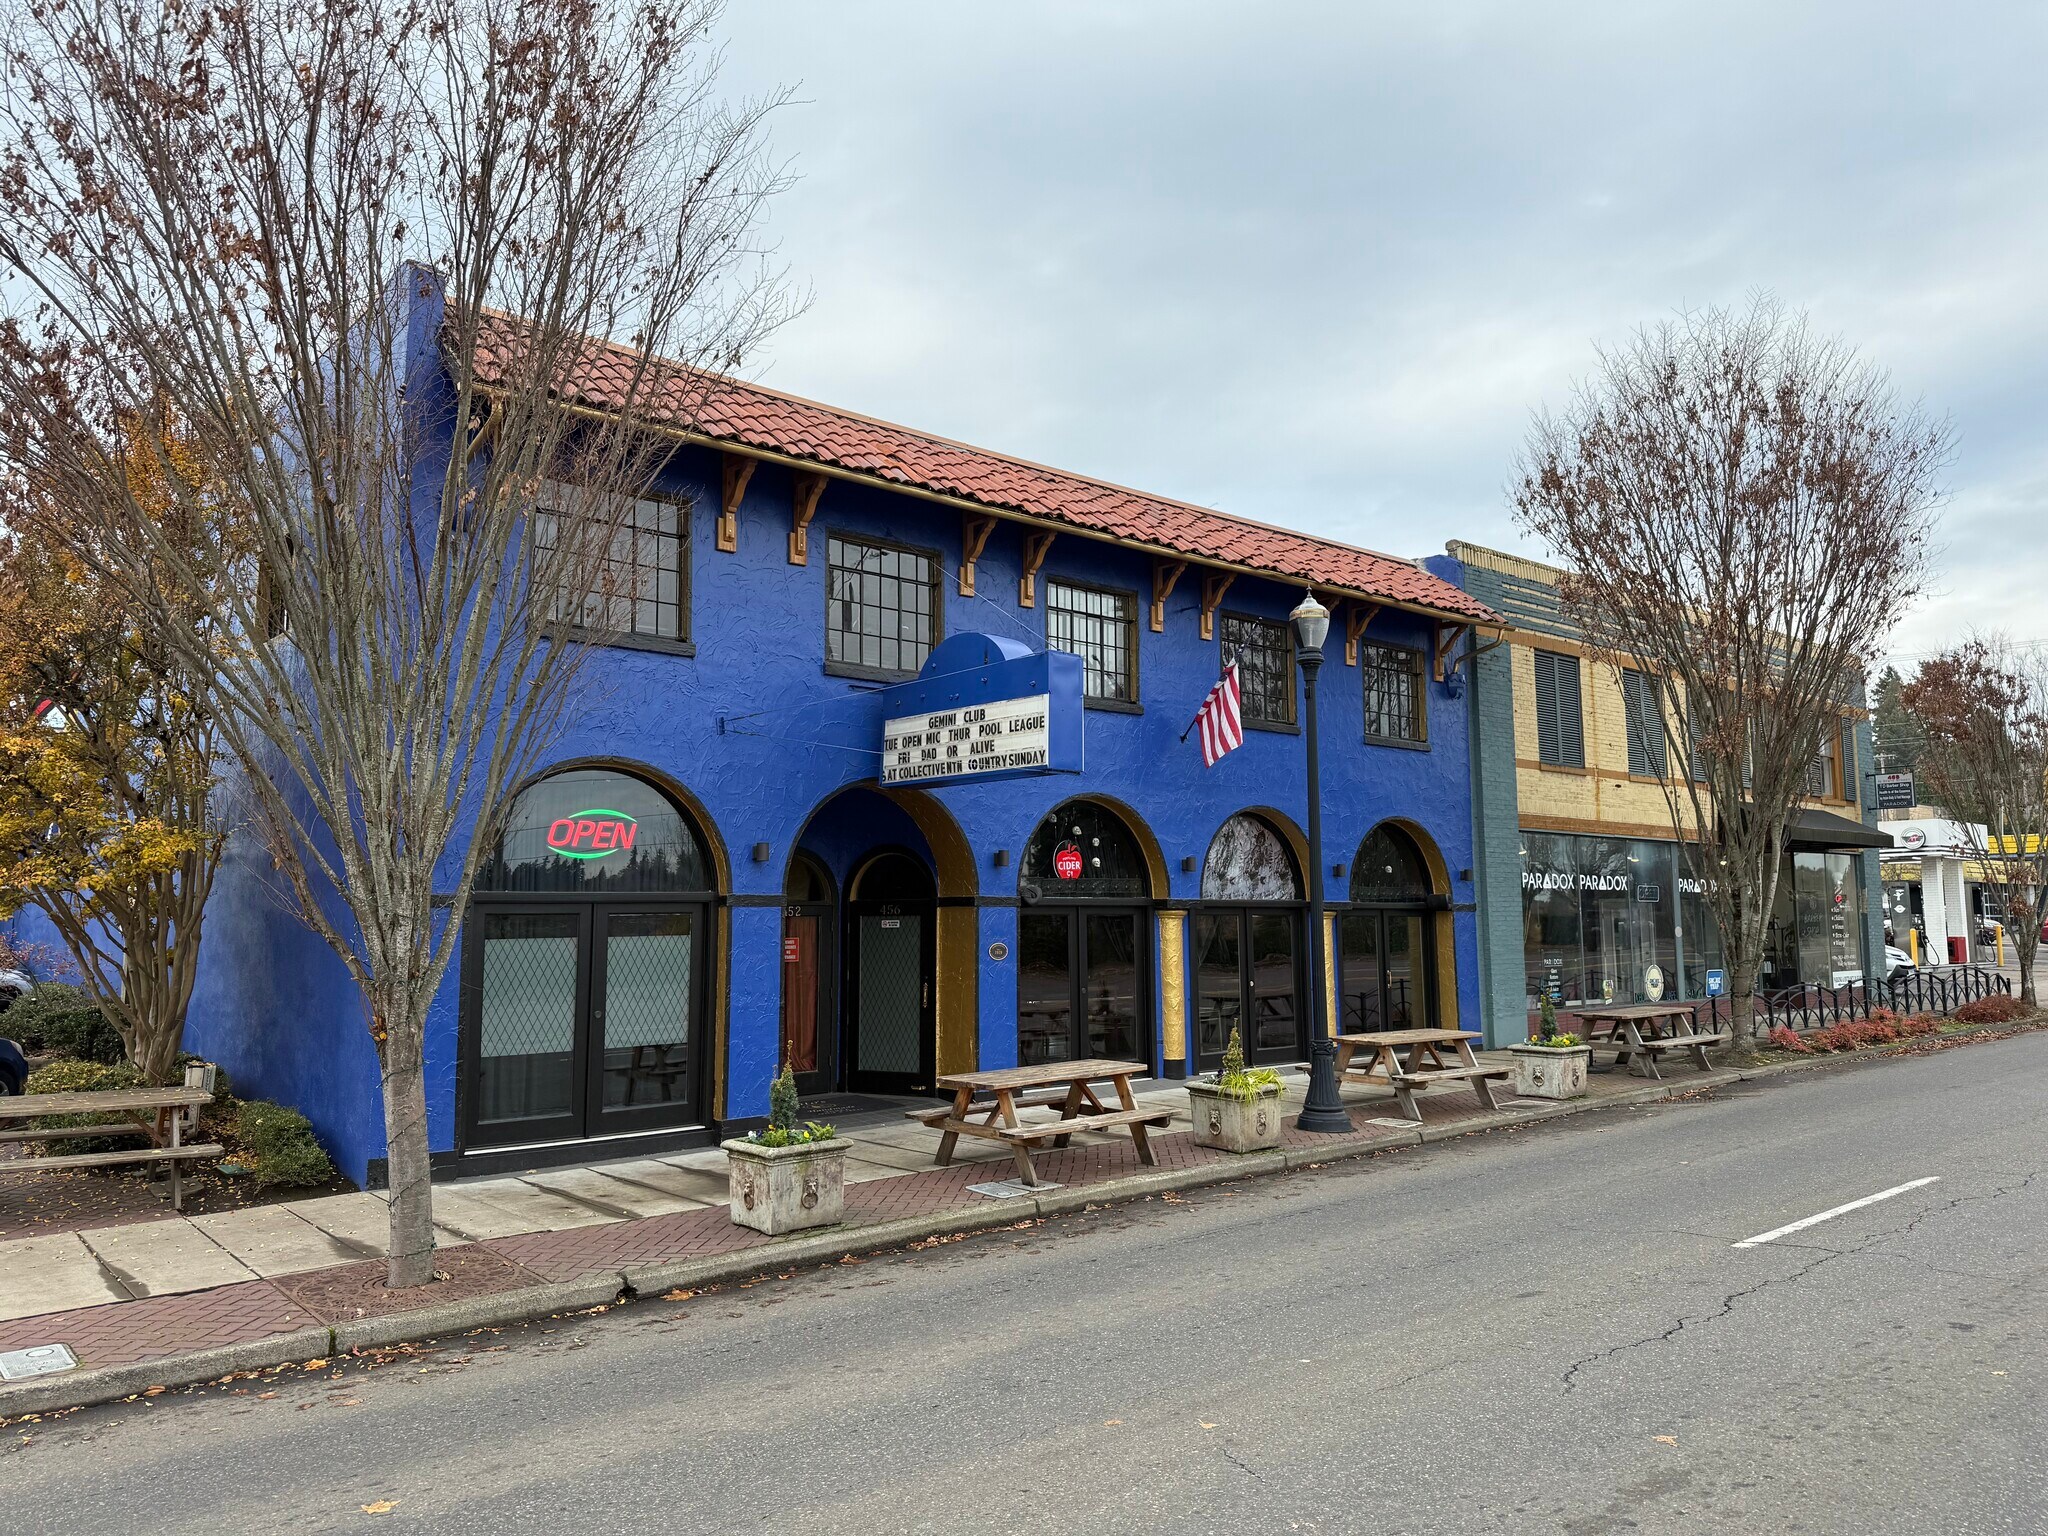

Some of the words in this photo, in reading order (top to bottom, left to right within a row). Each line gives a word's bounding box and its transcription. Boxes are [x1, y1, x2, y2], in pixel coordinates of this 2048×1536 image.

[928, 713, 957, 729] GEMINI
[964, 708, 986, 723] CLUB
[884, 738, 898, 751] TUE
[902, 734, 922, 749] OPEN
[926, 731, 941, 745] MIC
[948, 727, 970, 742] THUR
[979, 722, 1002, 737] POOL
[1009, 715, 1045, 733] LEAGUE
[898, 751, 910, 764] FRI
[921, 748, 937, 761] DAD
[946, 745, 958, 758] OR
[970, 740, 995, 755] ALIVE
[882, 769, 897, 782] SAT
[898, 762, 946, 779] COLLECTIVE
[968, 753, 1007, 771] COUNTRY
[1008, 749, 1046, 767] SUNDAY
[547, 819, 638, 849] OPEN
[1058, 861, 1081, 871] CIDER
[1521, 872, 1575, 890] PARADOX
[1579, 874, 1628, 891] PARADOX
